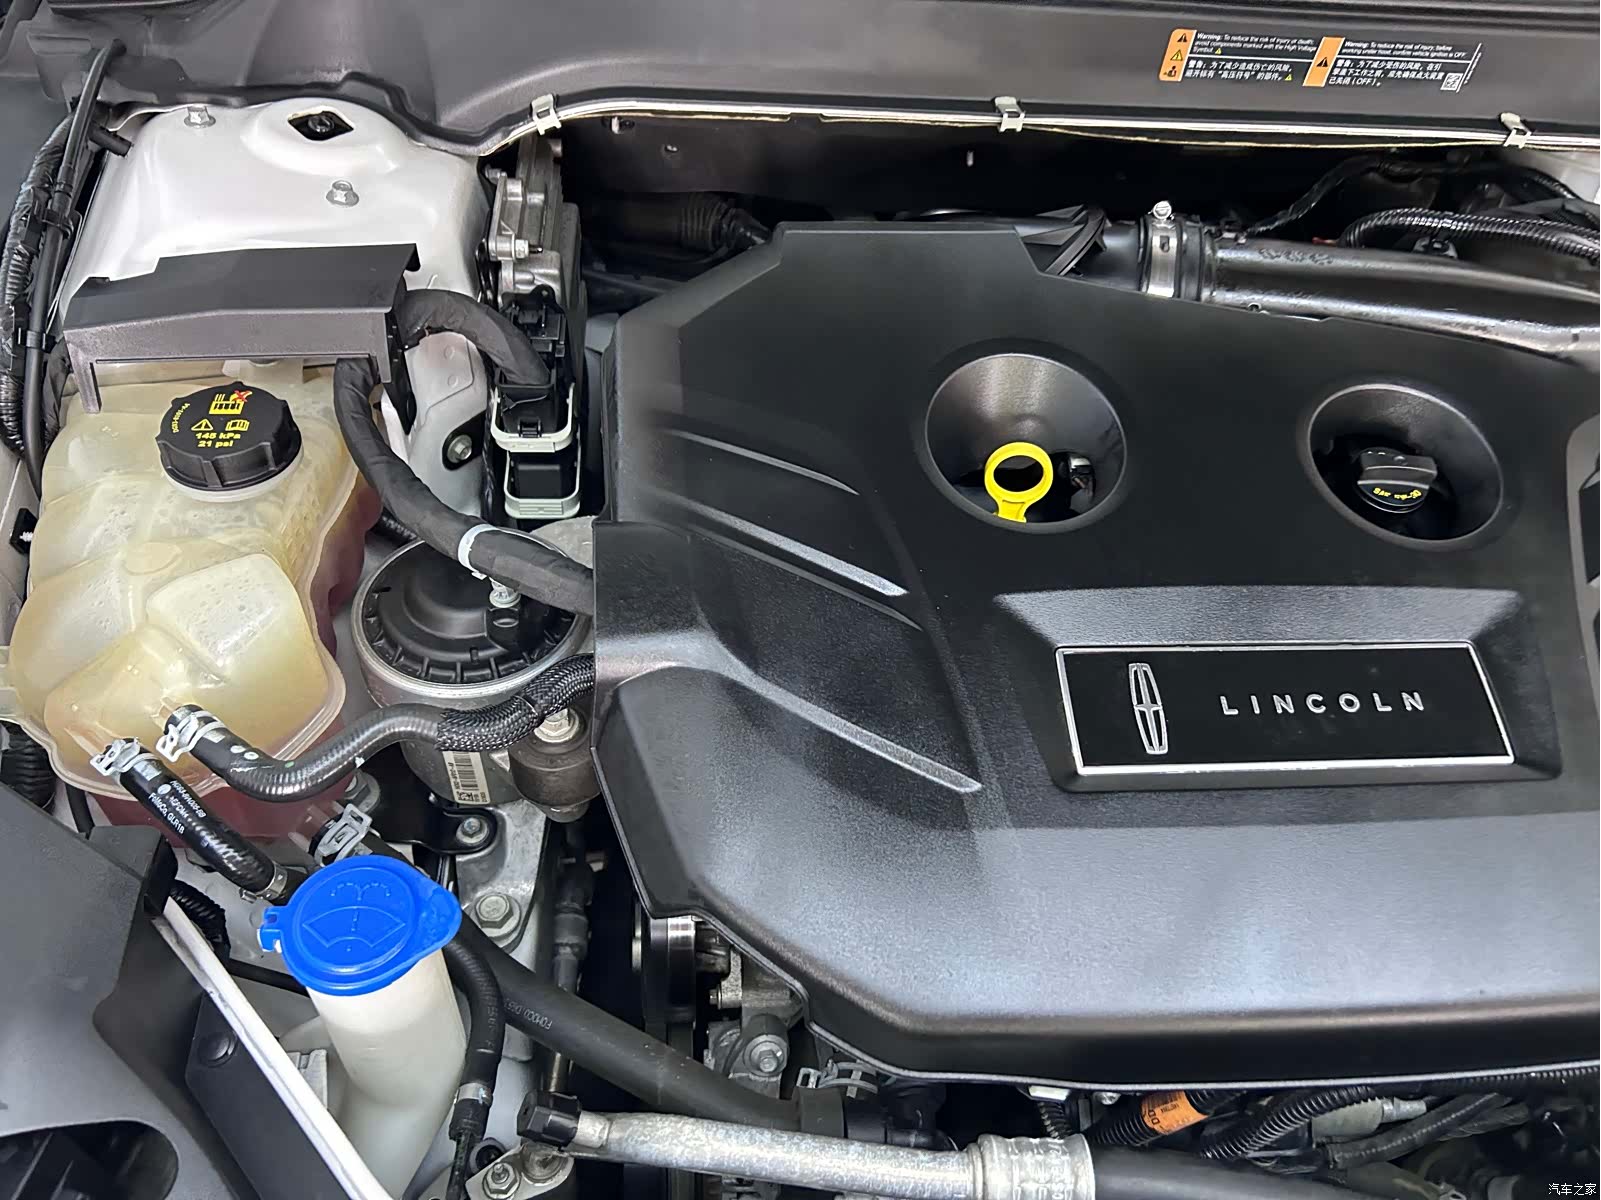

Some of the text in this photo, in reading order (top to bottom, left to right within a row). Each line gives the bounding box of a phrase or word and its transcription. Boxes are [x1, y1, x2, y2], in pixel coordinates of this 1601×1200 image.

[1197, 32, 1222, 42] Warning:
[1344, 40, 1369, 49] Warning:
[196, 432, 241, 440] 145 kPa
[197, 440, 234, 449] 21 psi
[1219, 691, 1425, 716] LINCOLN
